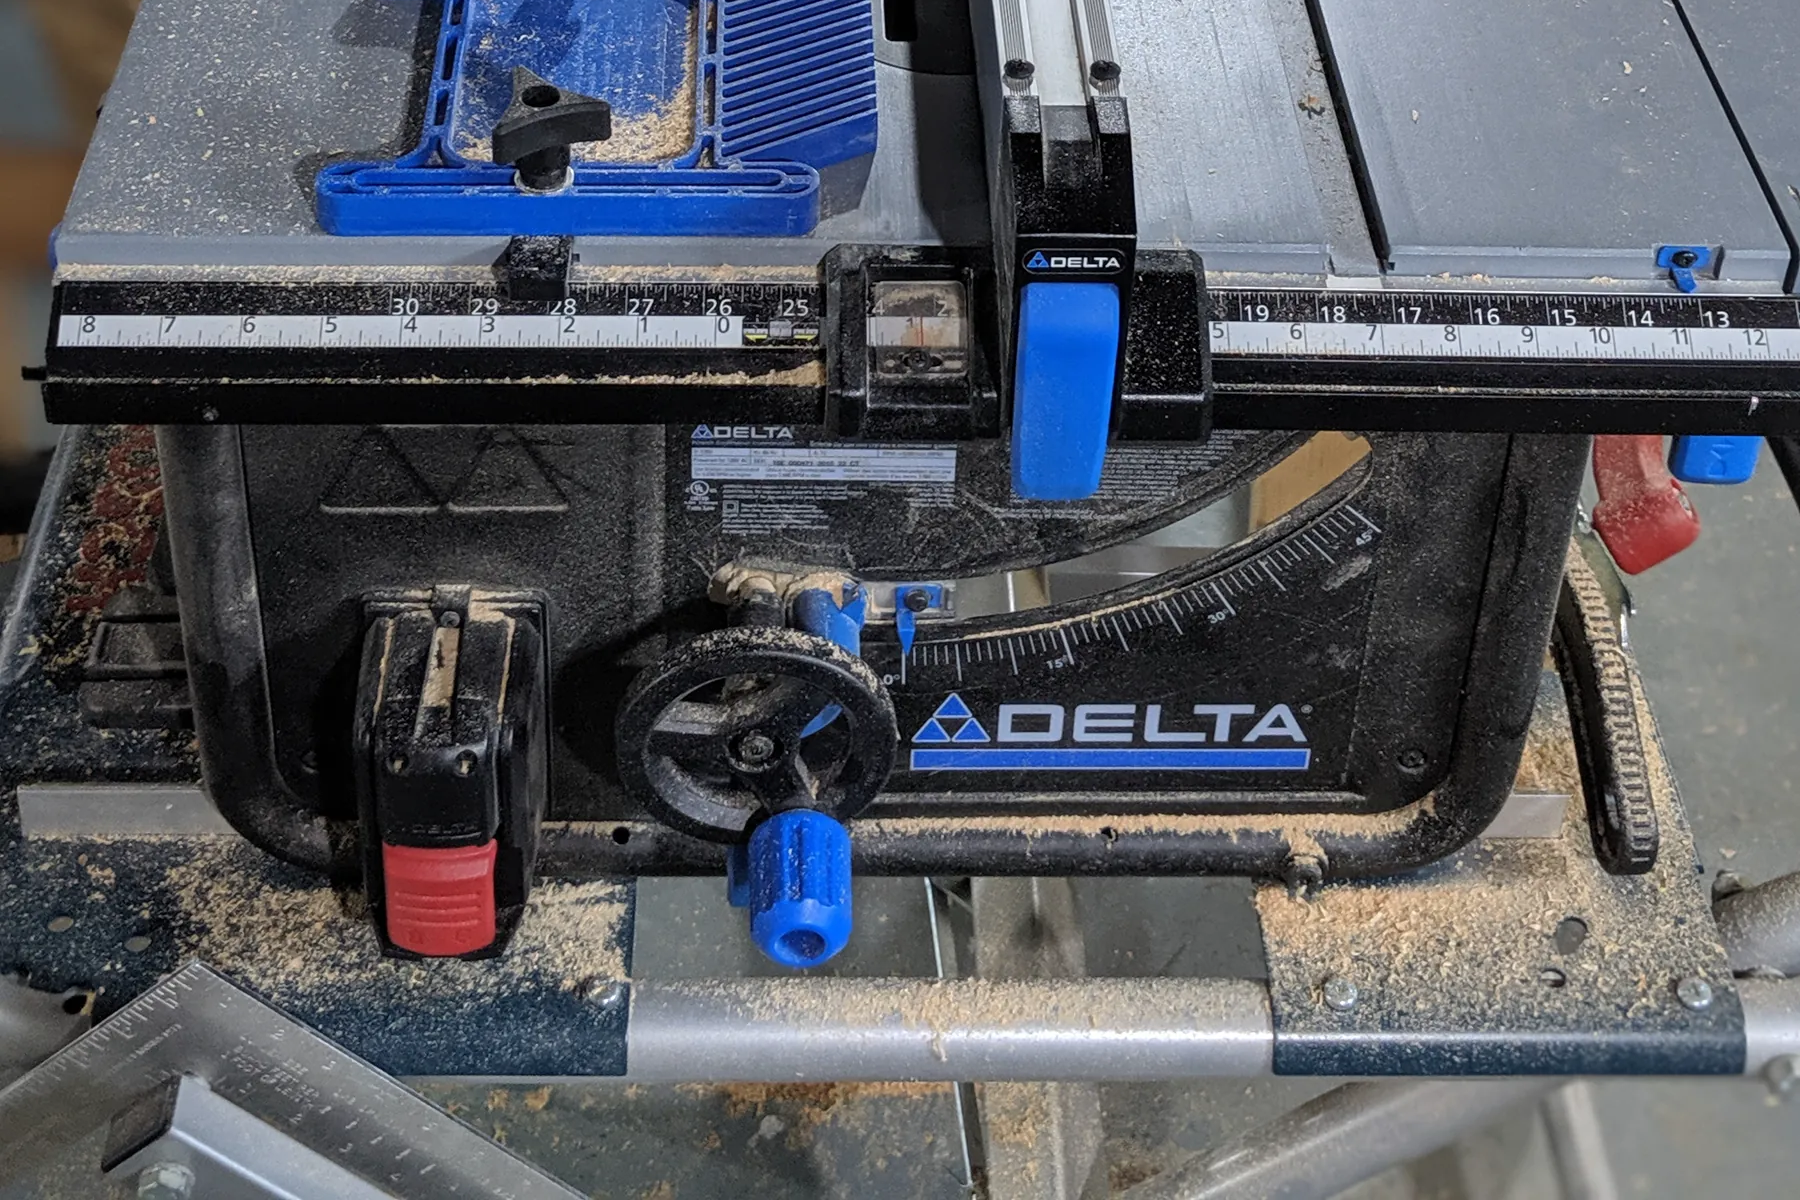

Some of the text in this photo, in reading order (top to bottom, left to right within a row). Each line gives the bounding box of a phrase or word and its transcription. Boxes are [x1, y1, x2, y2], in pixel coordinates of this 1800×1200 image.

[1050, 256, 1121, 269] DELTA
[391, 298, 810, 317] 30 29 28 27 26 25
[1244, 304, 1730, 328] 19 18 17 16 15 14 13
[82, 316, 730, 333] 8 7 6 5 4 3 2 1 0
[1212, 322, 1767, 346] 5 6 7 8 9 10 11 12
[713, 426, 793, 439] DELTA
[997, 703, 1308, 743] DELTA
